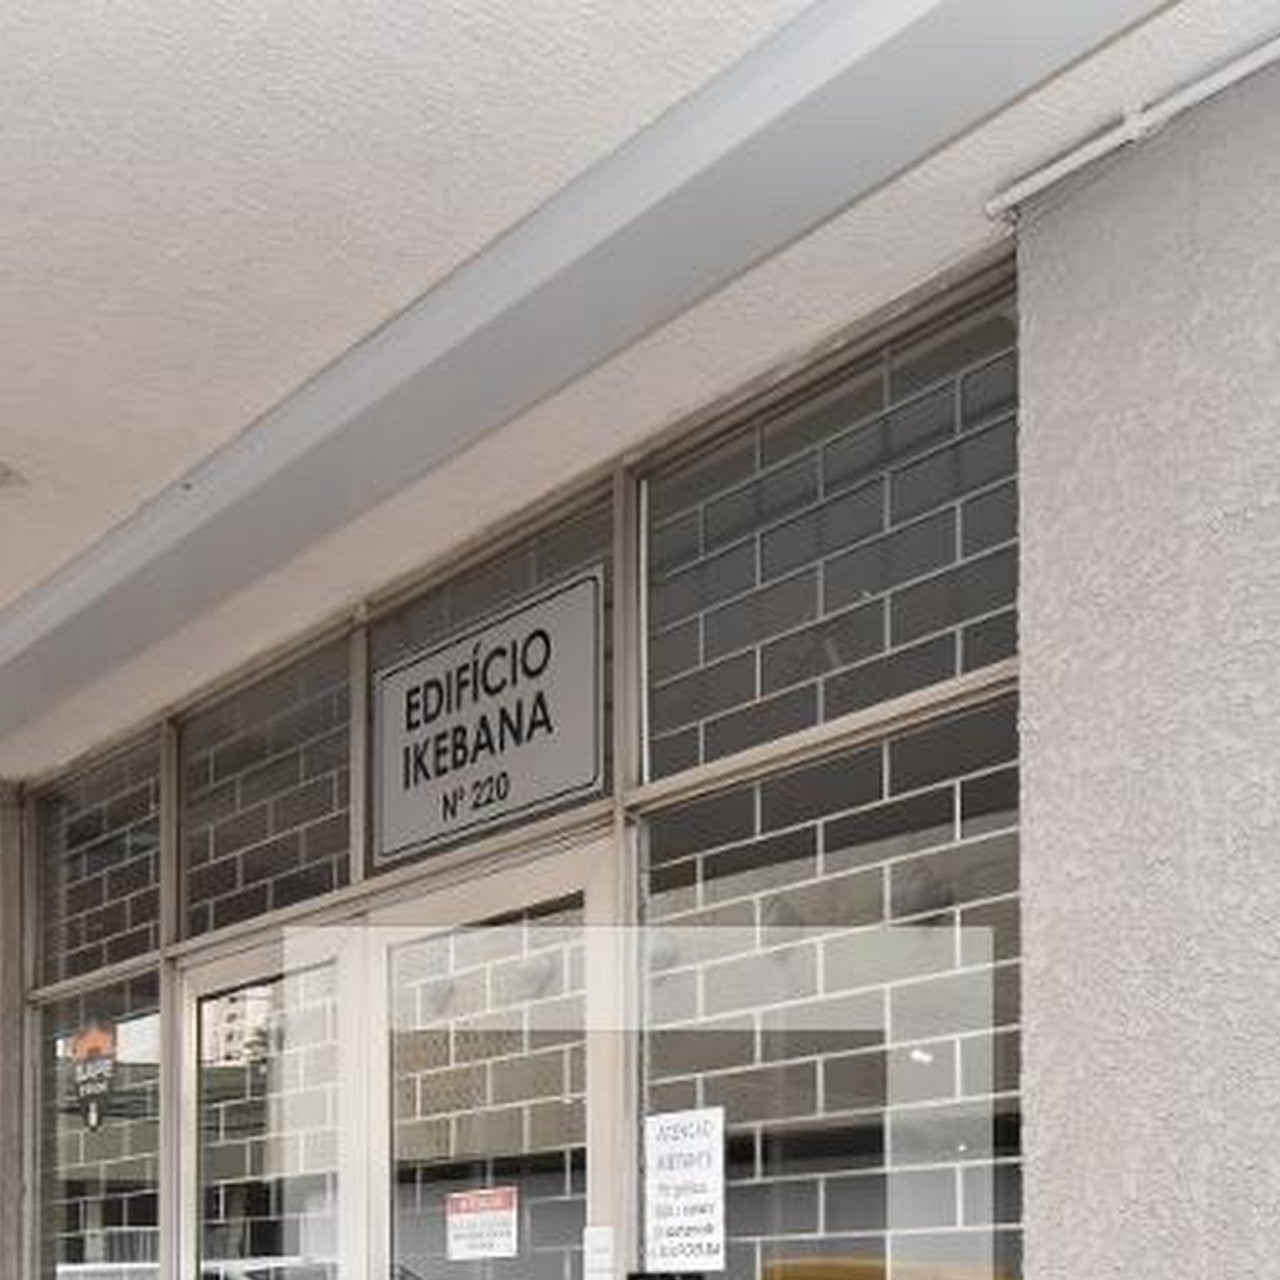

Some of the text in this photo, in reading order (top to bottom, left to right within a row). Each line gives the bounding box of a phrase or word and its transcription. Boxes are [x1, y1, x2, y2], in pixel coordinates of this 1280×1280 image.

[405, 629, 551, 731] EDIFÍCIO
[403, 692, 553, 790] IKEBANA
[472, 771, 510, 809] 220
